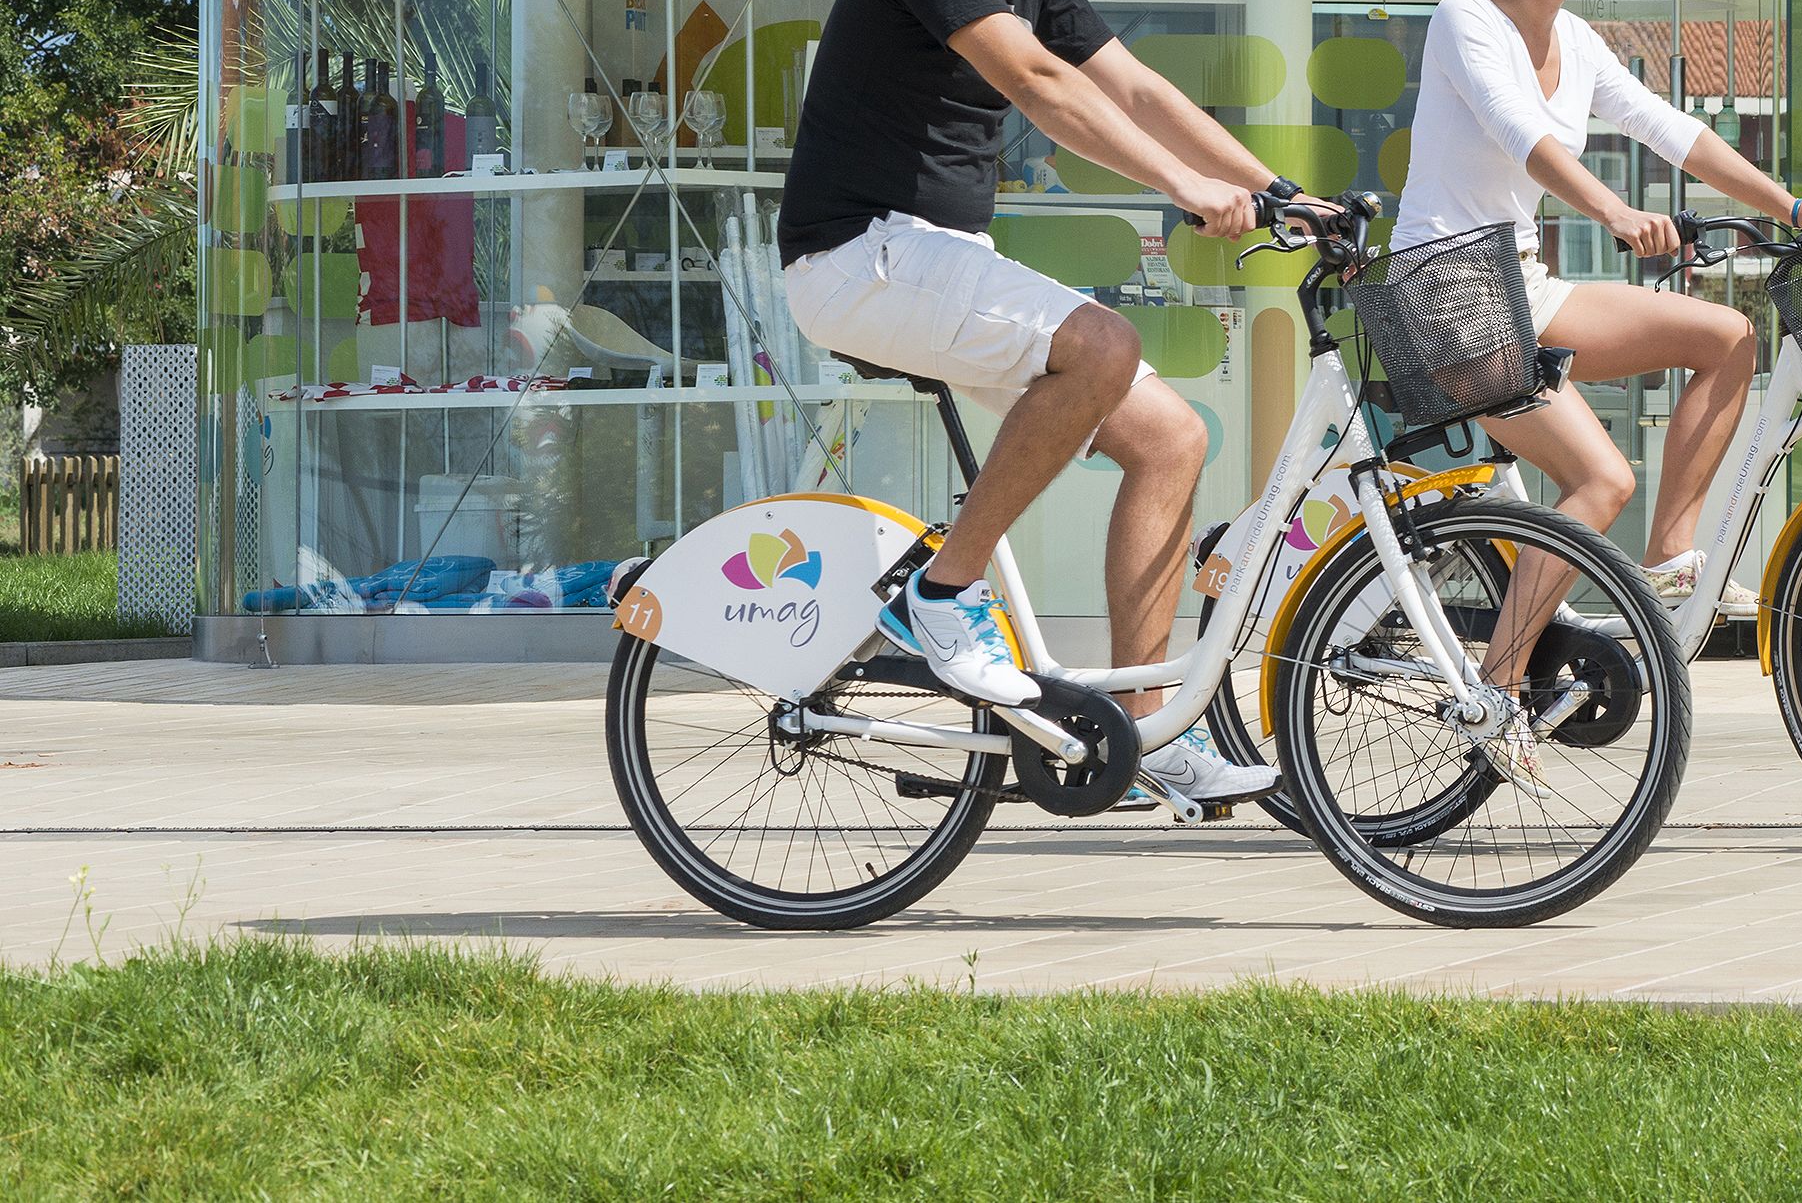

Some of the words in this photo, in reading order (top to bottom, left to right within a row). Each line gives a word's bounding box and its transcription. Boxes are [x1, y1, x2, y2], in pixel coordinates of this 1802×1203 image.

[1141, 237, 1164, 248] Dobri
[1717, 416, 1767, 545] parkandrideUmag.com
[1230, 453, 1293, 595] parkandrideUmag.com
[1208, 568, 1229, 592] 19
[628, 603, 654, 631] 11
[724, 598, 820, 647] umag
[1365, 875, 1392, 896] REACH
